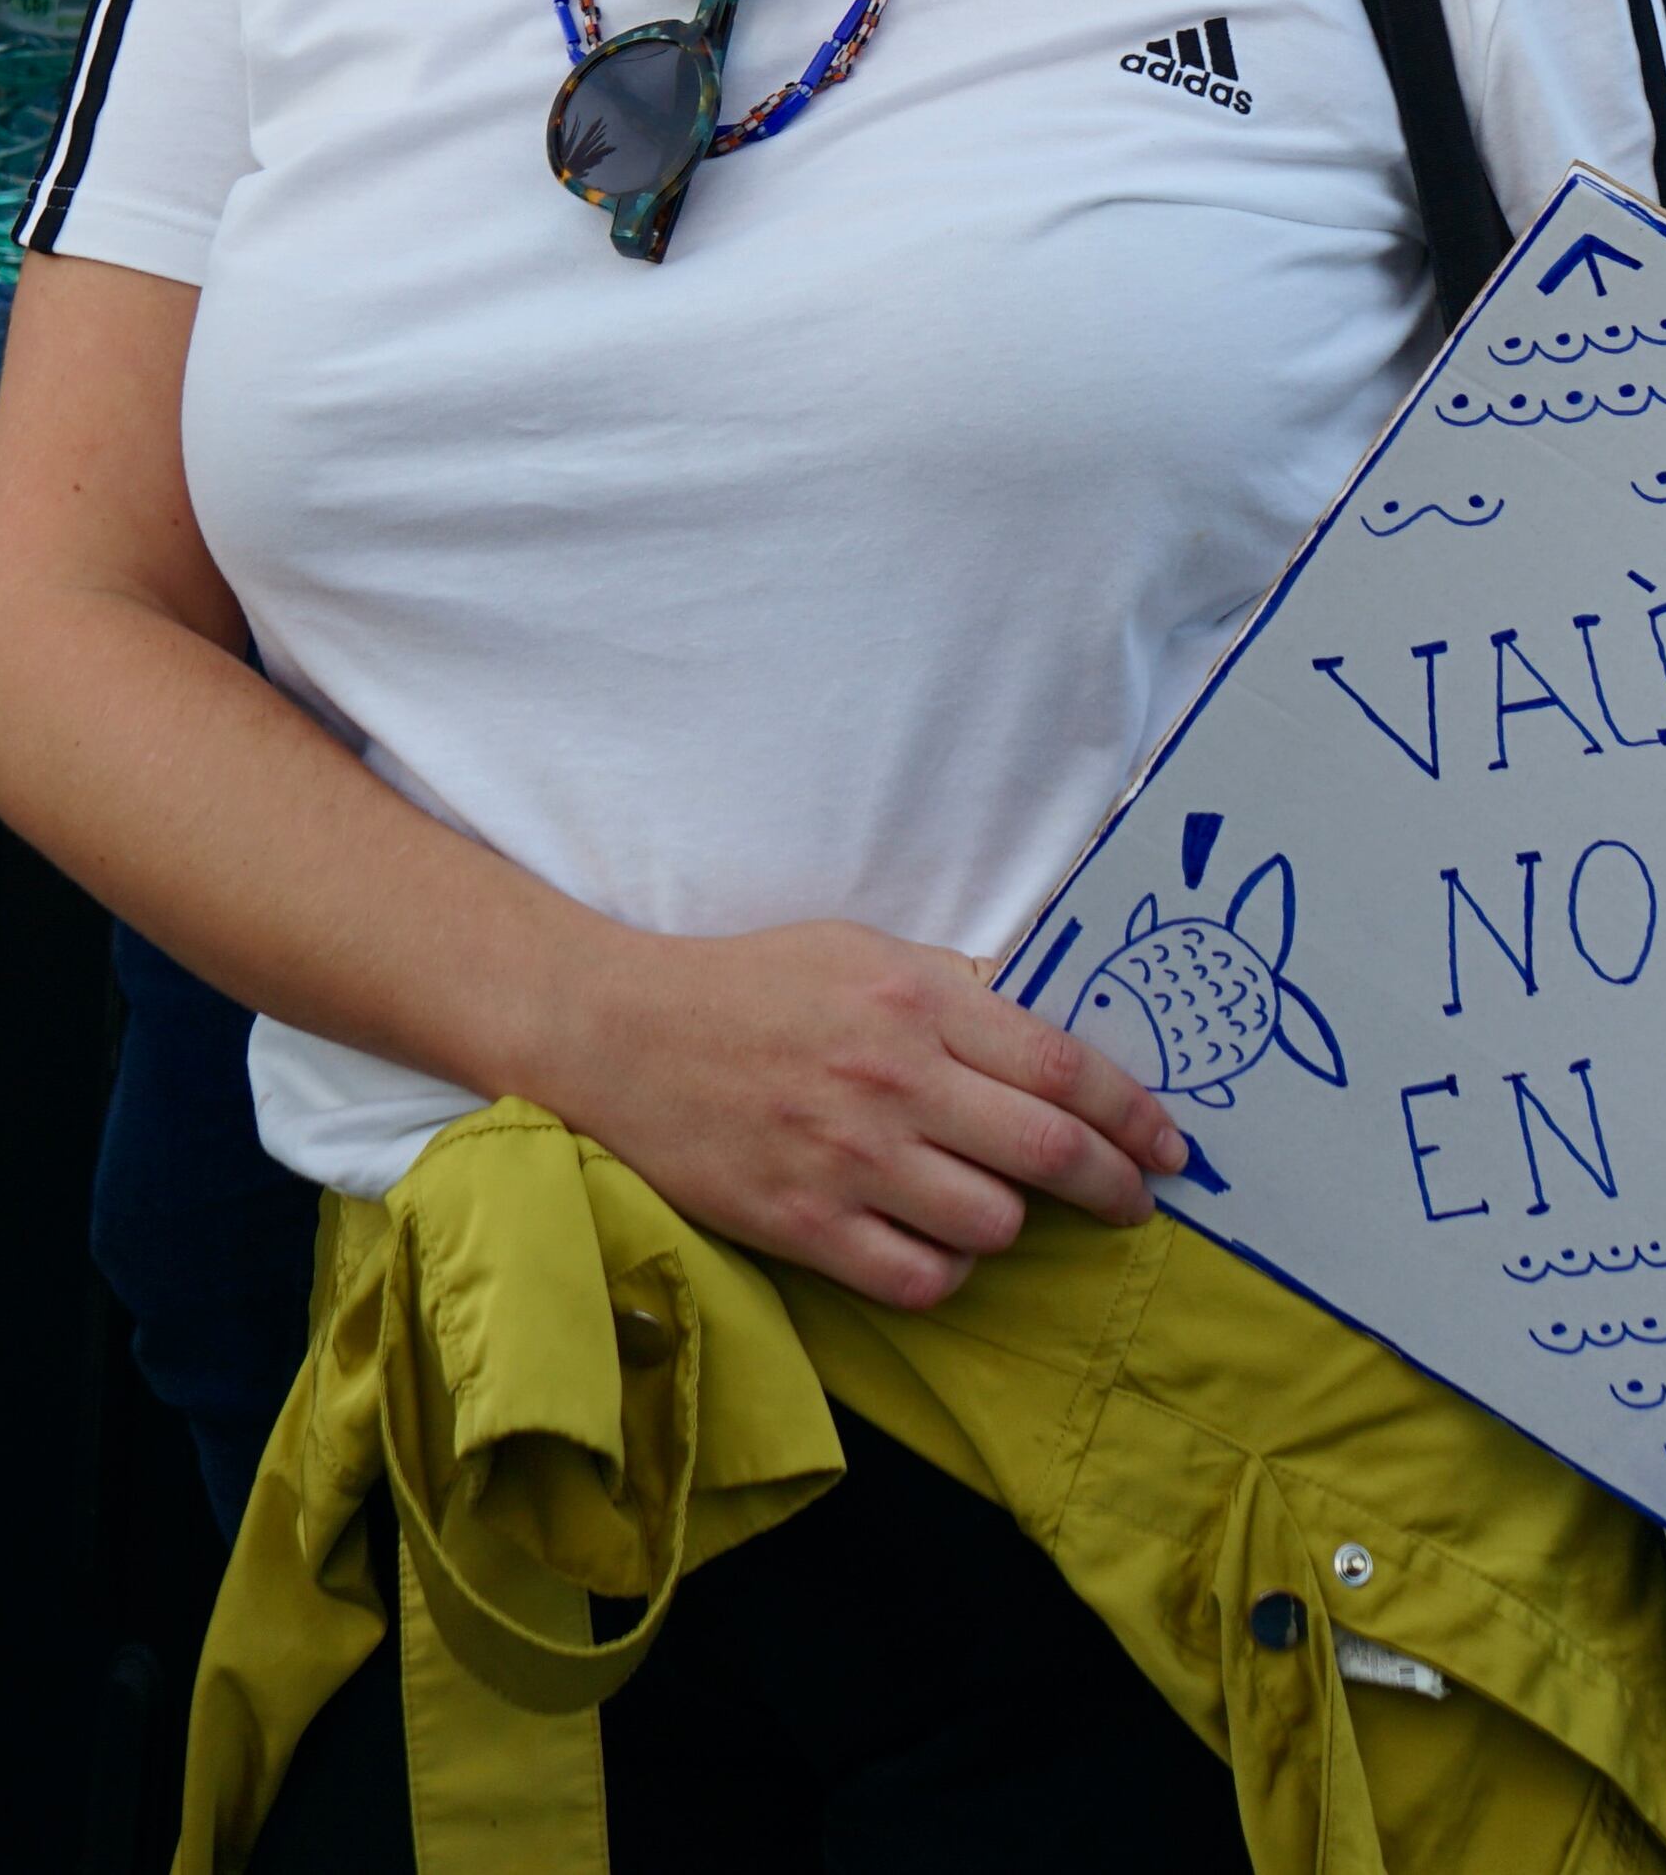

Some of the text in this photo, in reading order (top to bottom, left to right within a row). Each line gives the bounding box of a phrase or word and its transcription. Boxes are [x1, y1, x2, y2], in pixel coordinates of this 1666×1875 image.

[1119, 53, 1253, 116] adidas
[1439, 839, 1657, 1015] NO
[1400, 1058, 1619, 1222] EN
